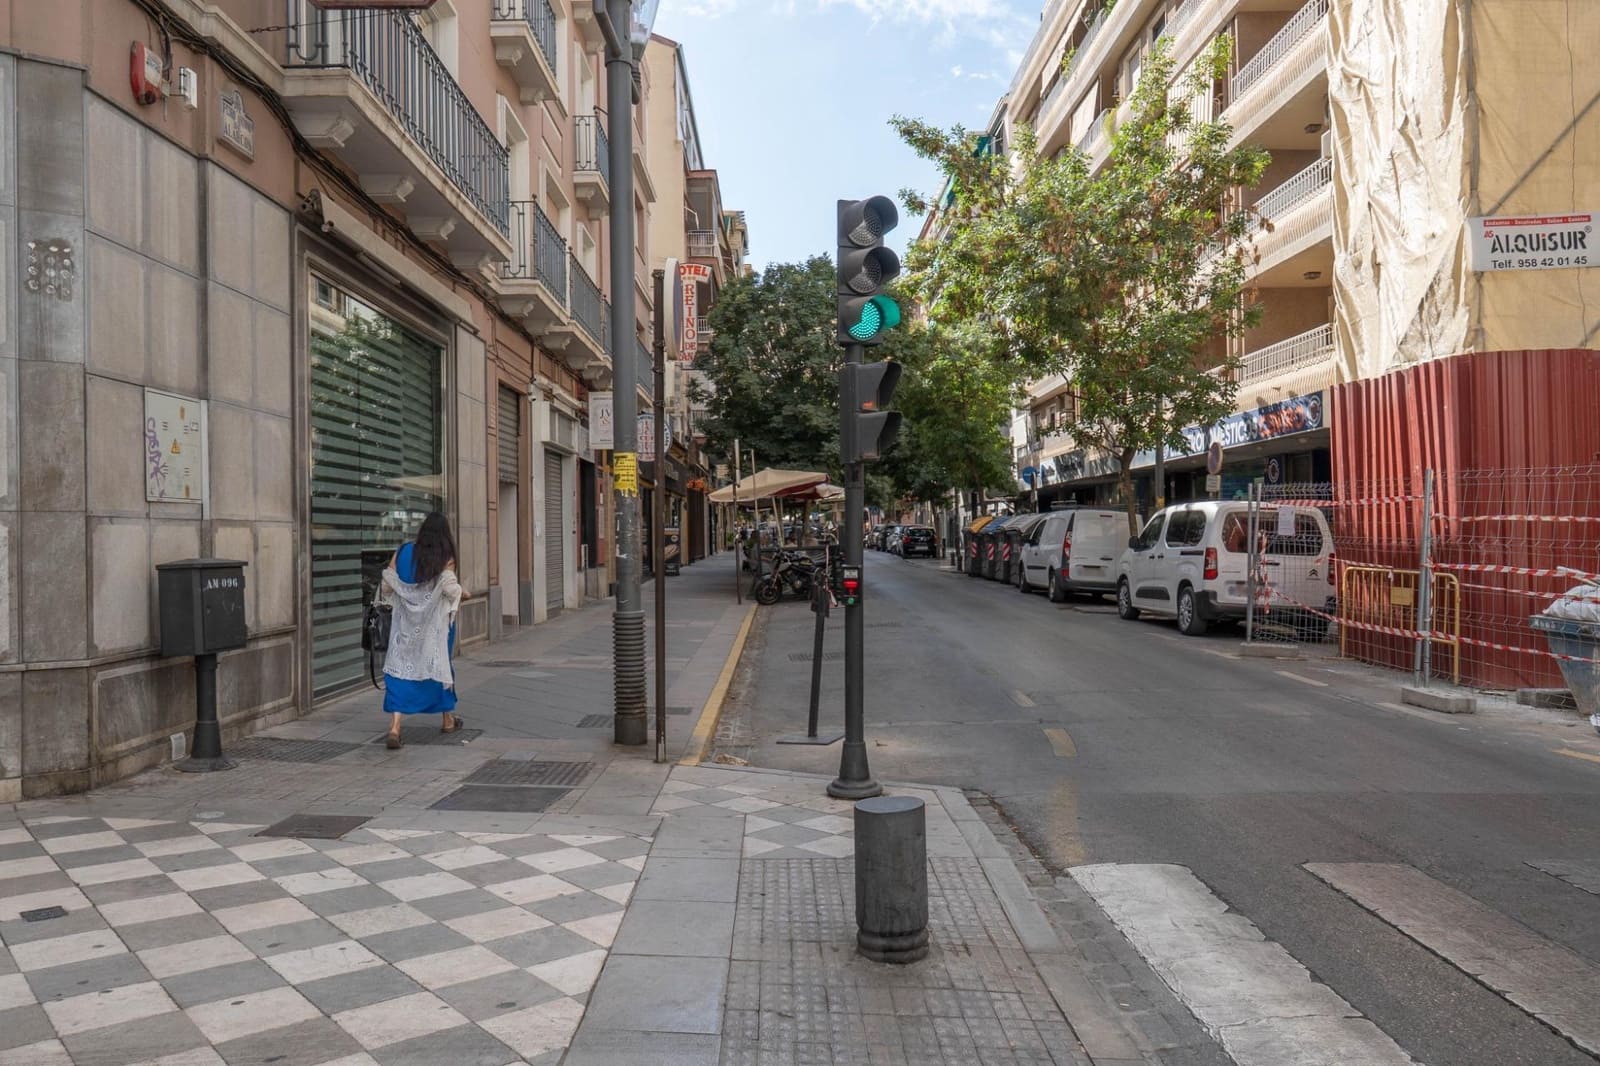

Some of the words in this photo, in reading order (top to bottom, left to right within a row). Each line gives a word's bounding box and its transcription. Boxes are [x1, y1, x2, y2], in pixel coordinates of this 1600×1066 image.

[1491, 259, 1515, 269] Telf.
[1518, 258, 1538, 268] 958
[1541, 257, 1554, 267] 42
[1557, 257, 1570, 266] 01
[1574, 255, 1587, 265] 45
[679, 265, 708, 277] OTEL
[684, 283, 696, 340] REINO
